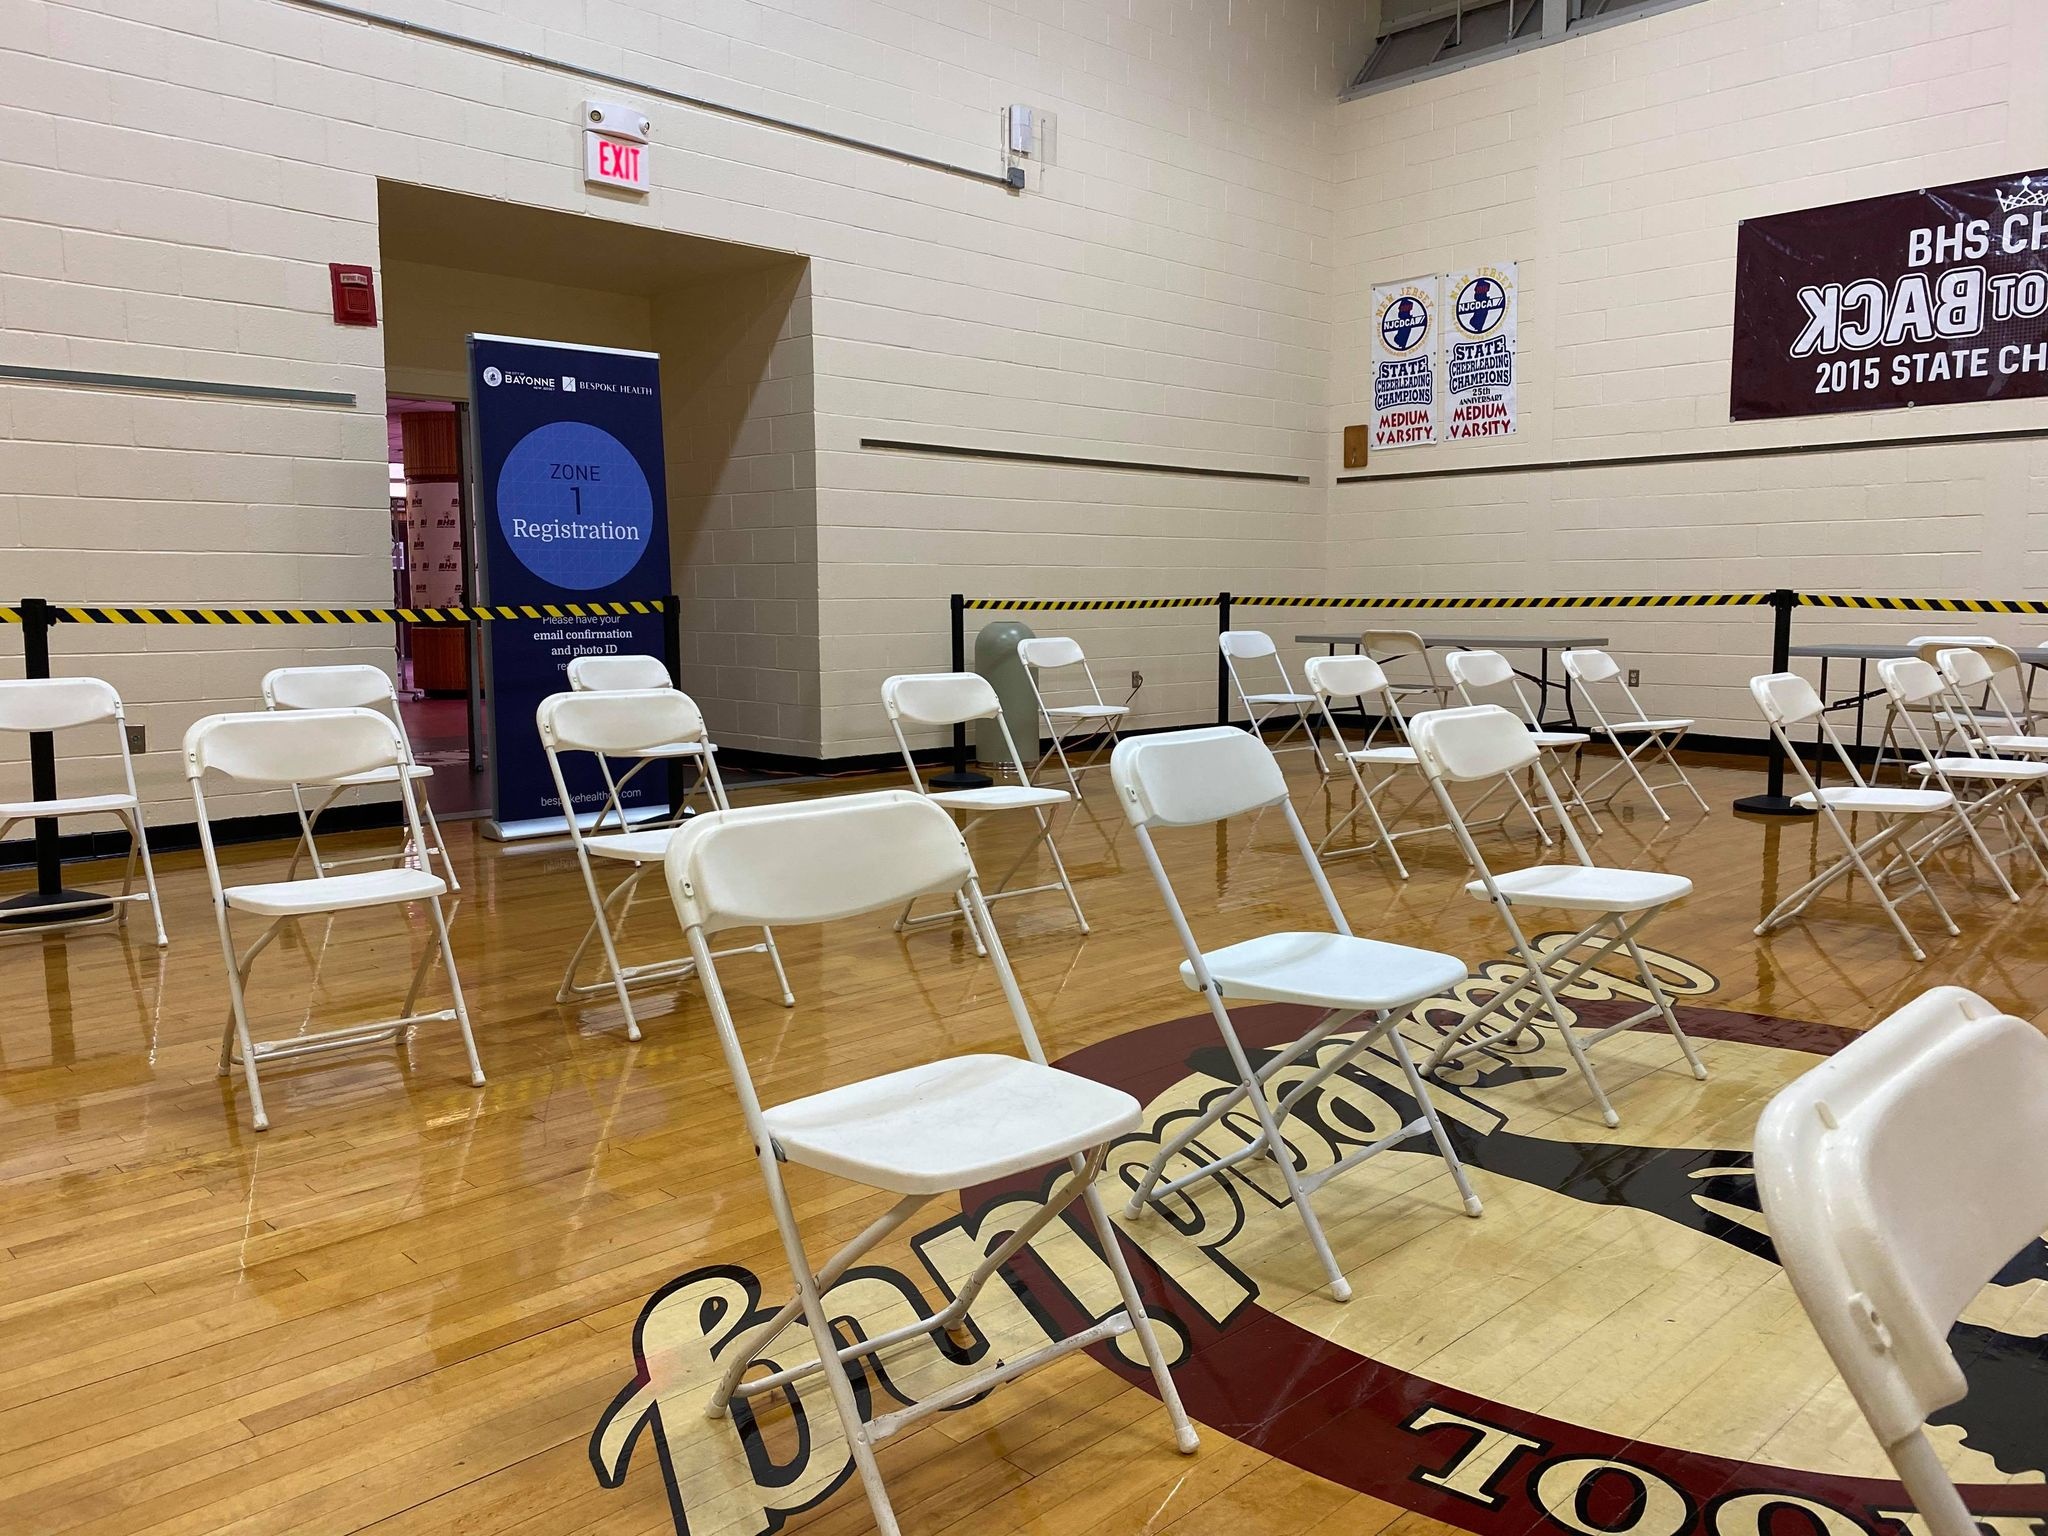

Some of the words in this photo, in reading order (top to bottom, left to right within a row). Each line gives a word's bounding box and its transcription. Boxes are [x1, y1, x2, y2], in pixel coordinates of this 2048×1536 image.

[598, 141, 641, 182] EXIT
[1908, 219, 1991, 268] BHS
[1989, 269, 2048, 321] TO
[1458, 299, 1493, 313] NJCDCA
[1383, 317, 1416, 331] NJCDCA
[1456, 338, 1504, 361] STATE
[1382, 358, 1427, 379] STATE
[1451, 354, 1509, 376] CHEERLEADING
[1815, 357, 1880, 394] 2015
[1891, 347, 1989, 387] STATE
[504, 374, 555, 388] BAYONNE
[579, 381, 617, 393] BESPOKE
[620, 385, 652, 396] HEALTH
[1376, 374, 1431, 394] CHEERLEADING
[1451, 369, 1509, 392] CHAMPIONS
[1376, 388, 1431, 408] CHAMPIONS
[1472, 387, 1491, 397] 25th
[1379, 410, 1429, 429] MEDIUM
[1453, 403, 1508, 422] MEDIUM
[1376, 426, 1433, 445] VARSITY
[1450, 419, 1511, 439] VARSITY
[550, 463, 601, 482] ZONE
[570, 486, 581, 516] 1
[512, 518, 640, 543] Registration
[599, 615, 621, 626] your
[533, 629, 564, 641] email
[565, 629, 633, 641] confirmation
[551, 645, 571, 656] and
[573, 645, 603, 658] photo
[605, 645, 618, 655] ID
